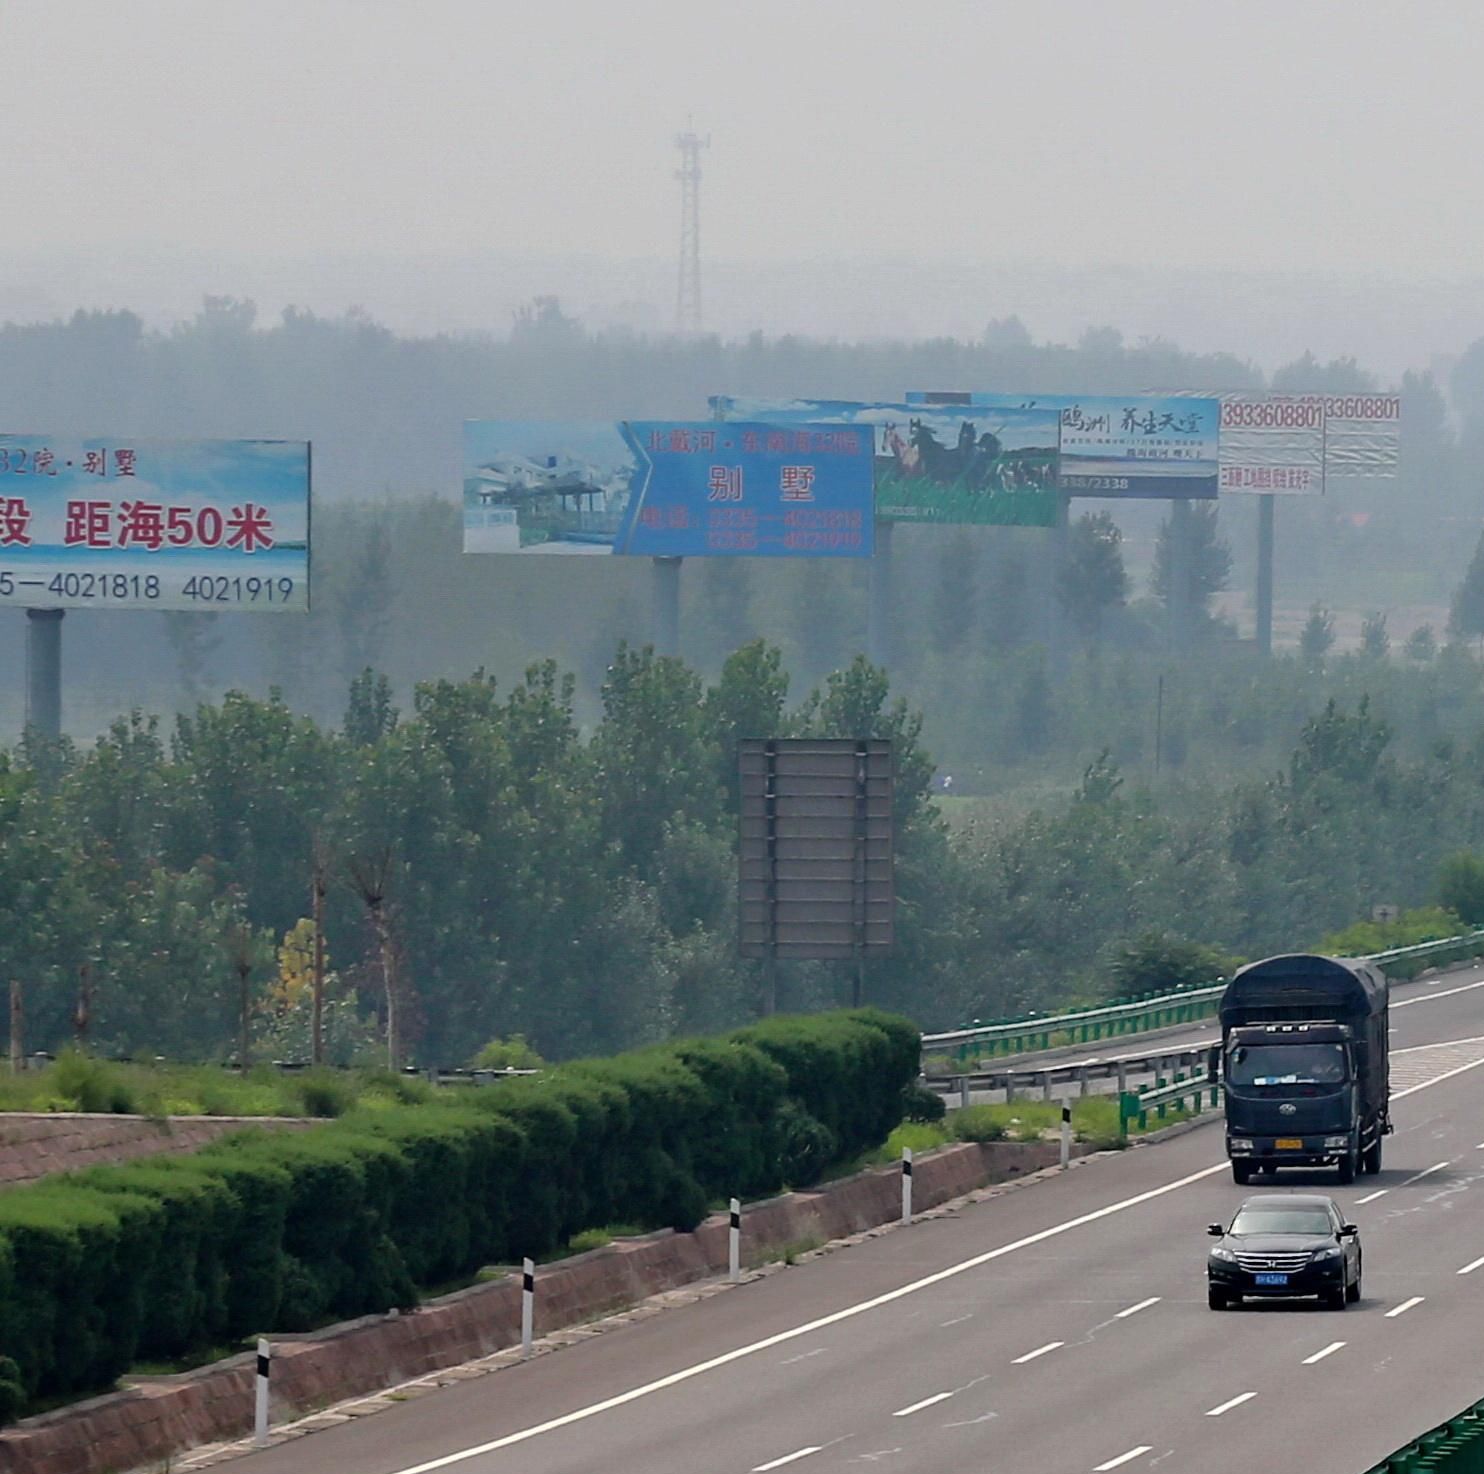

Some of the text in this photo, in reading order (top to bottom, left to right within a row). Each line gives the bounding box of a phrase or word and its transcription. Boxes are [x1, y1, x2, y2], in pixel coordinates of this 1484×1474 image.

[64, 499, 274, 552] 距海50米
[182, 576, 294, 601] 4021919
